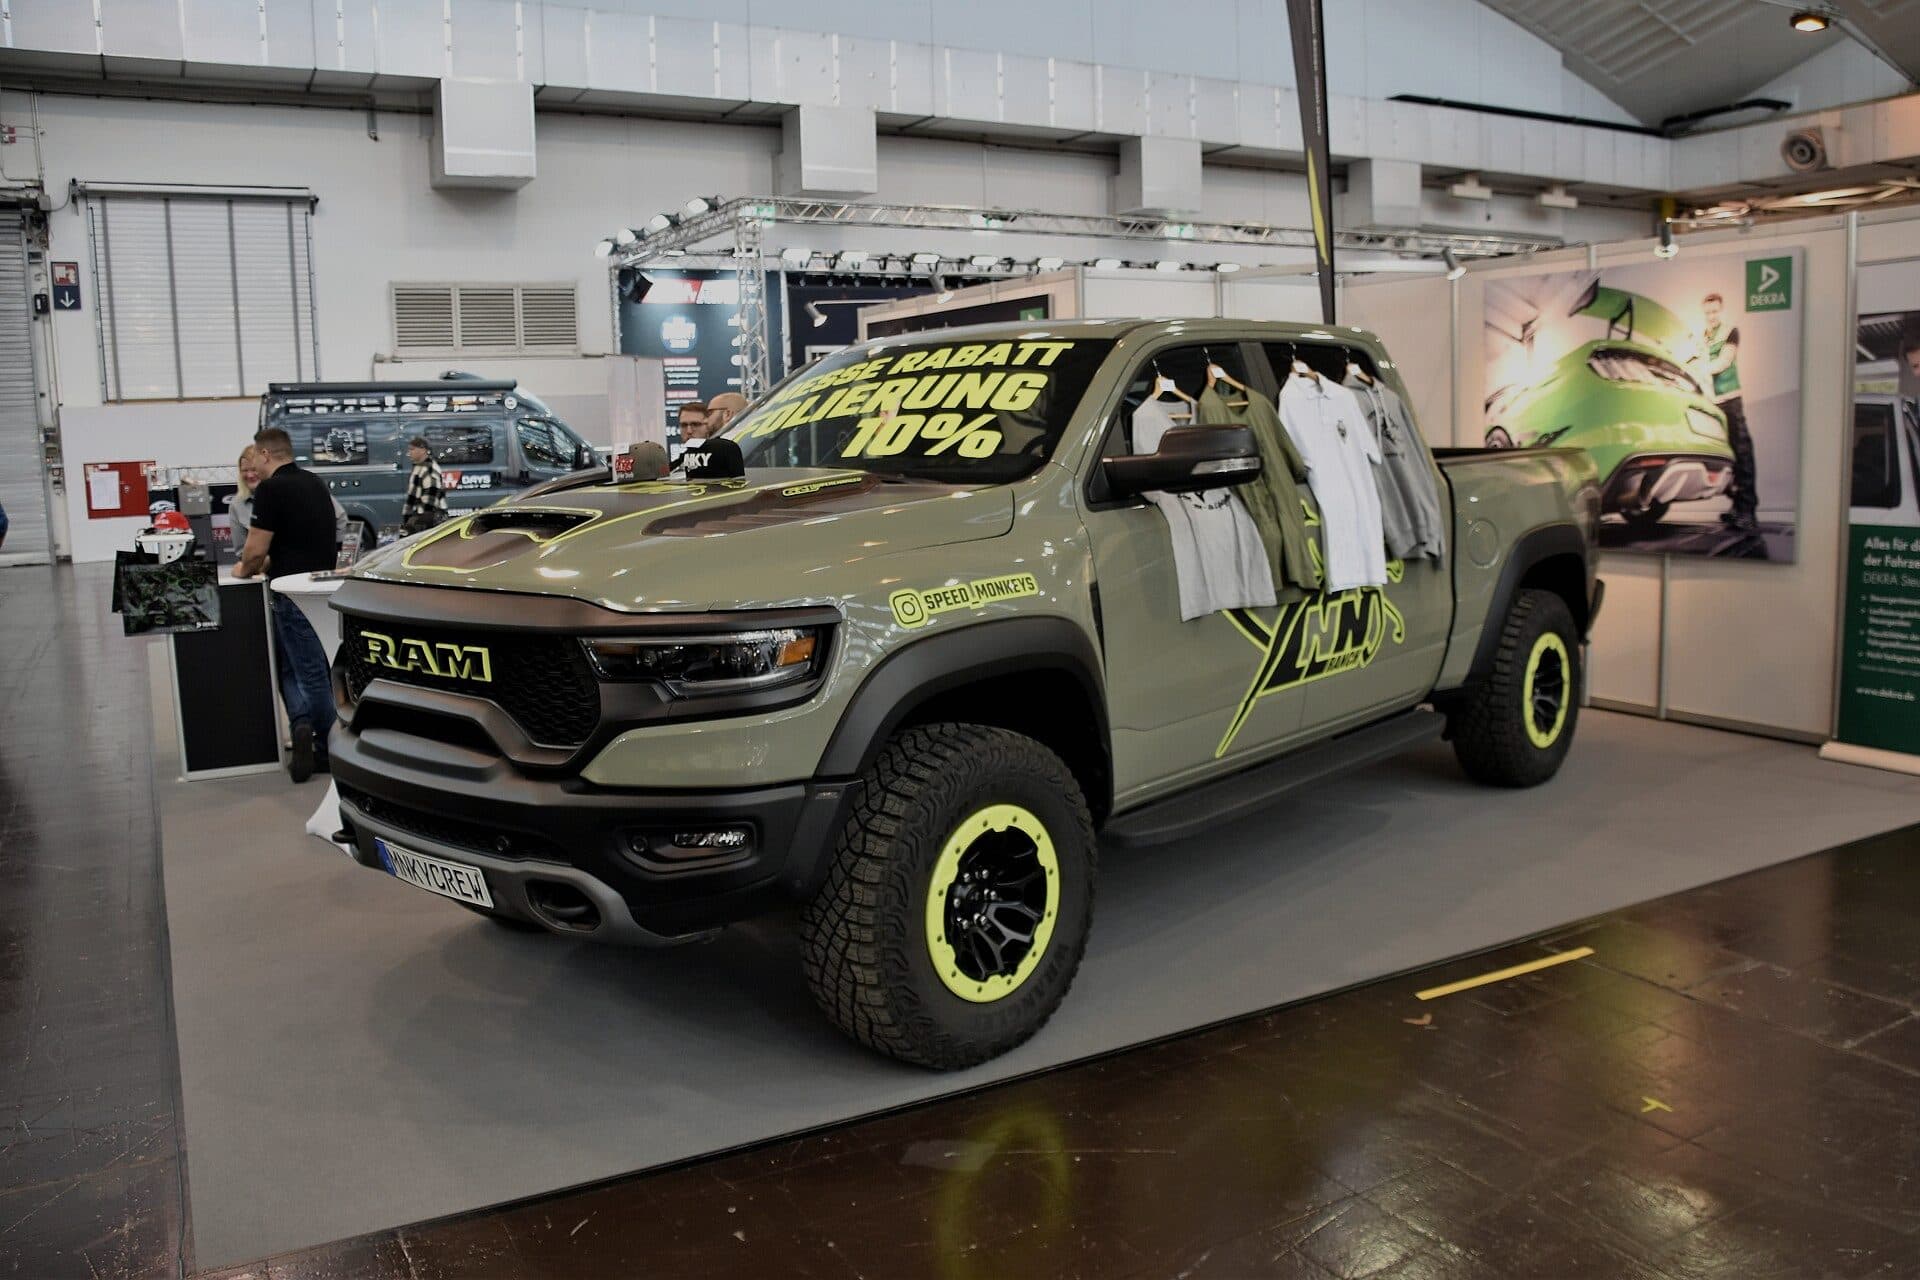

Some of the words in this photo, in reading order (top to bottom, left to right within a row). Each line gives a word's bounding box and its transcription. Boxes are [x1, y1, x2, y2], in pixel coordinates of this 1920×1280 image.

[1750, 292, 1786, 306] DEKRA
[891, 342, 1075, 376] RABATT
[841, 413, 1002, 459] 10%
[1864, 537, 1890, 551] Alles
[1863, 553, 1882, 567] der
[360, 630, 492, 683] RAM
